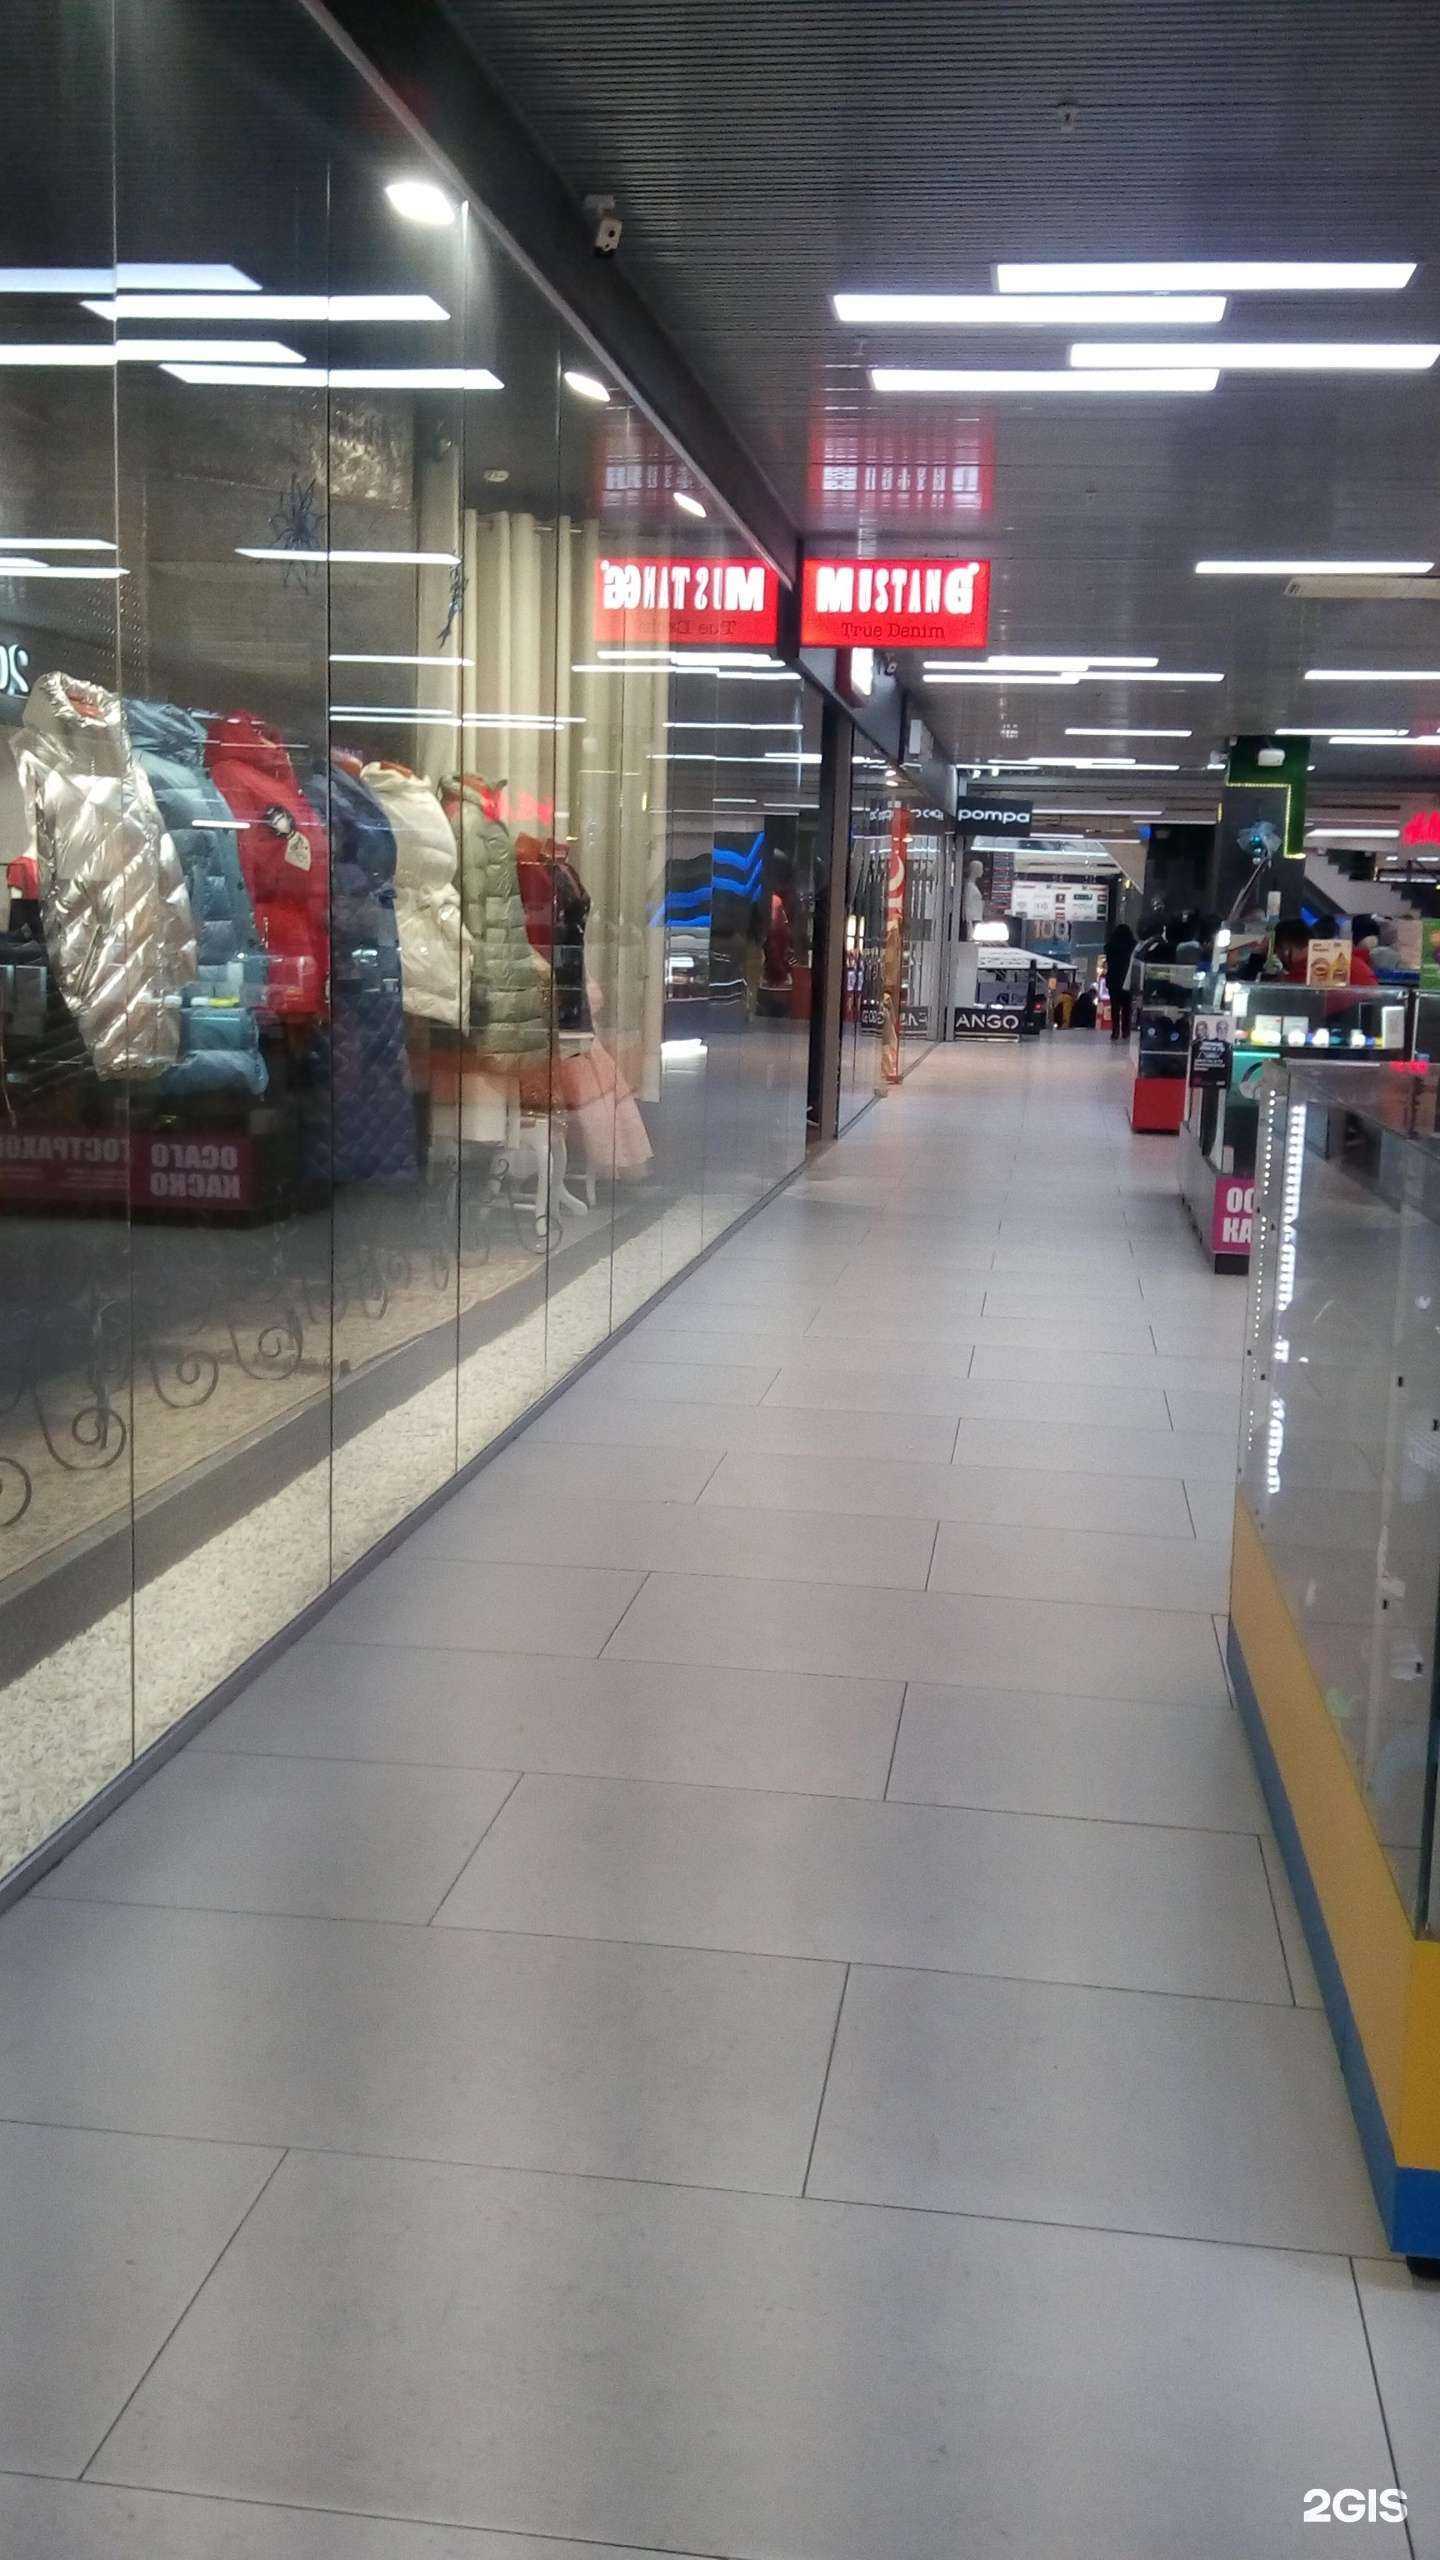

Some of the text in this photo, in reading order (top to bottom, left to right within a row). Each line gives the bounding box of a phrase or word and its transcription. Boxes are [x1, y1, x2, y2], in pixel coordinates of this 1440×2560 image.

[816, 562, 979, 615] MUSTANG
[841, 622, 945, 640] True Denim
[958, 809, 1031, 824] pompa
[956, 1014, 1020, 1030] ANGO
